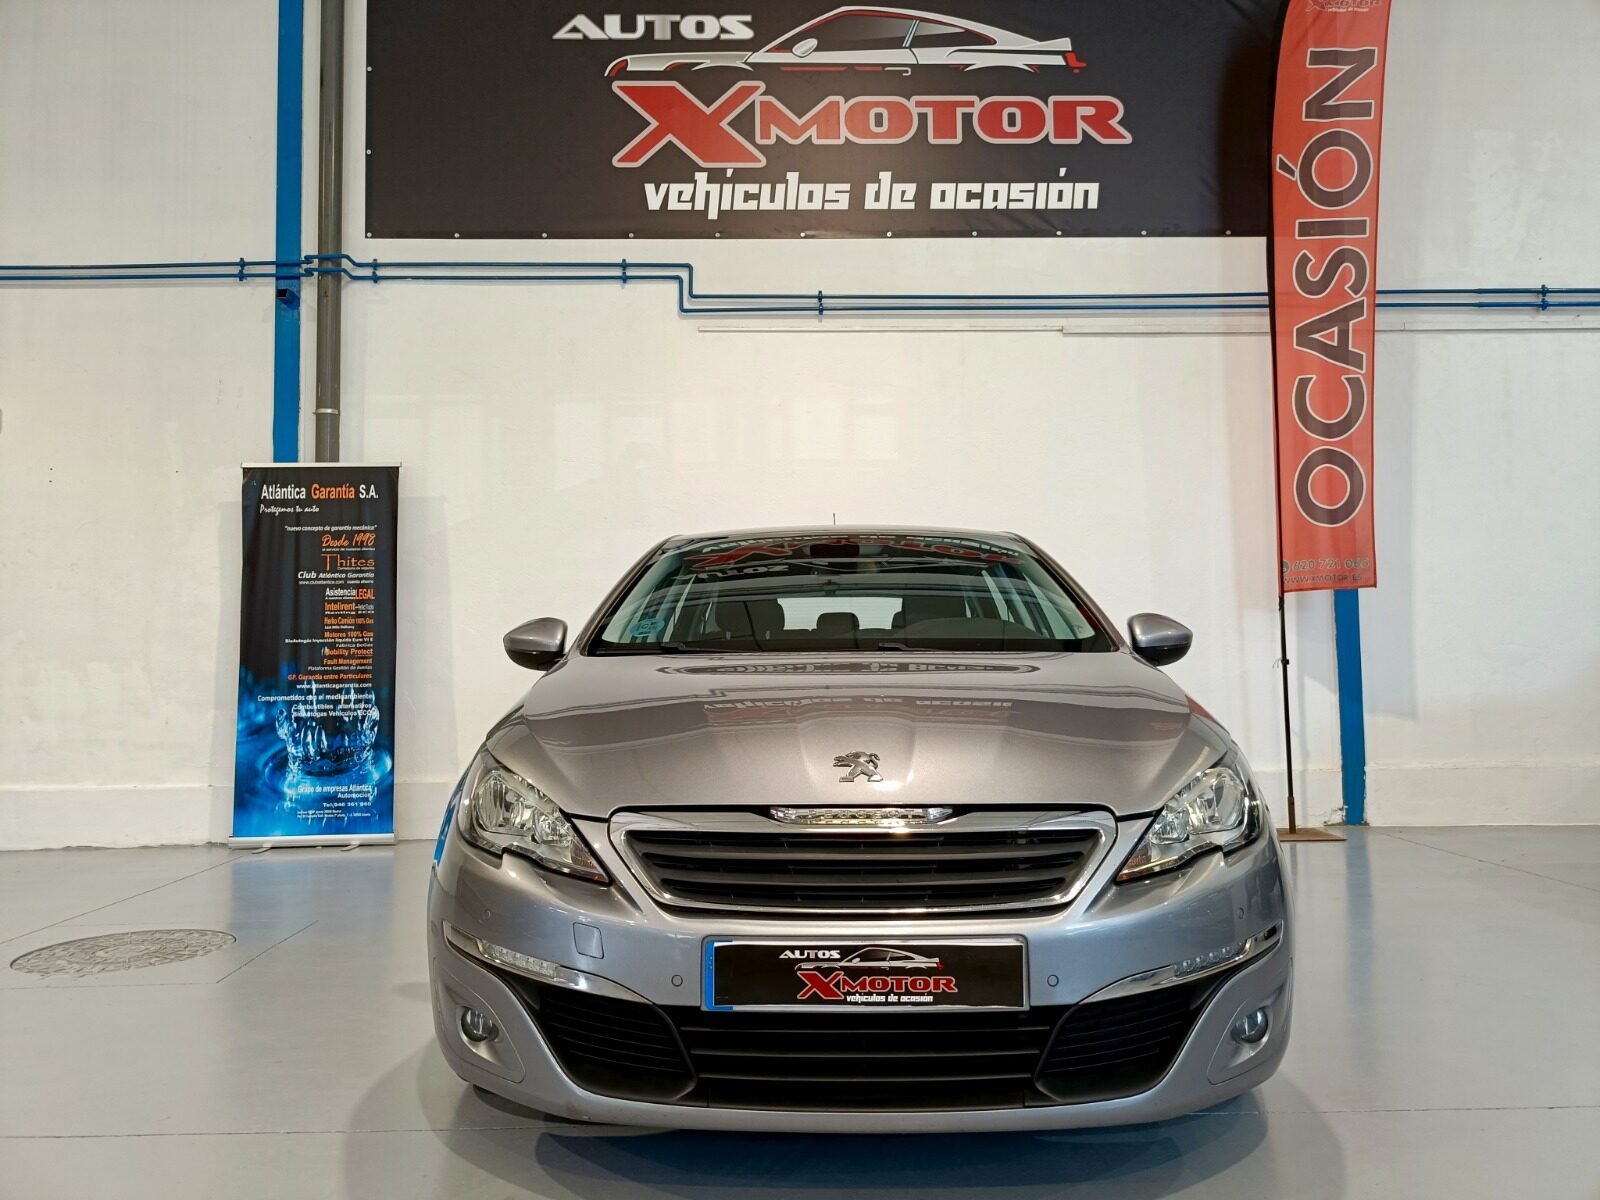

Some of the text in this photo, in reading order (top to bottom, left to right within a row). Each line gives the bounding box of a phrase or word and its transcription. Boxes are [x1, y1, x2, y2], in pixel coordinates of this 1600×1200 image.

[552, 14, 754, 41] AUTOS
[612, 80, 1132, 168] XMOTOR
[643, 168, 1099, 220] vehículos de ocasión
[1276, 47, 1378, 527] OCASIÓN
[261, 483, 379, 499] Atlántica Garantía S.A.
[304, 505, 320, 513] auto
[322, 533, 376, 547] Desde 1998
[298, 571, 317, 579] Club
[257, 694, 305, 702] Comprometidos
[779, 950, 841, 959] AUTOS
[797, 971, 958, 999] XMOTOR
[888, 993, 898, 1002] de
